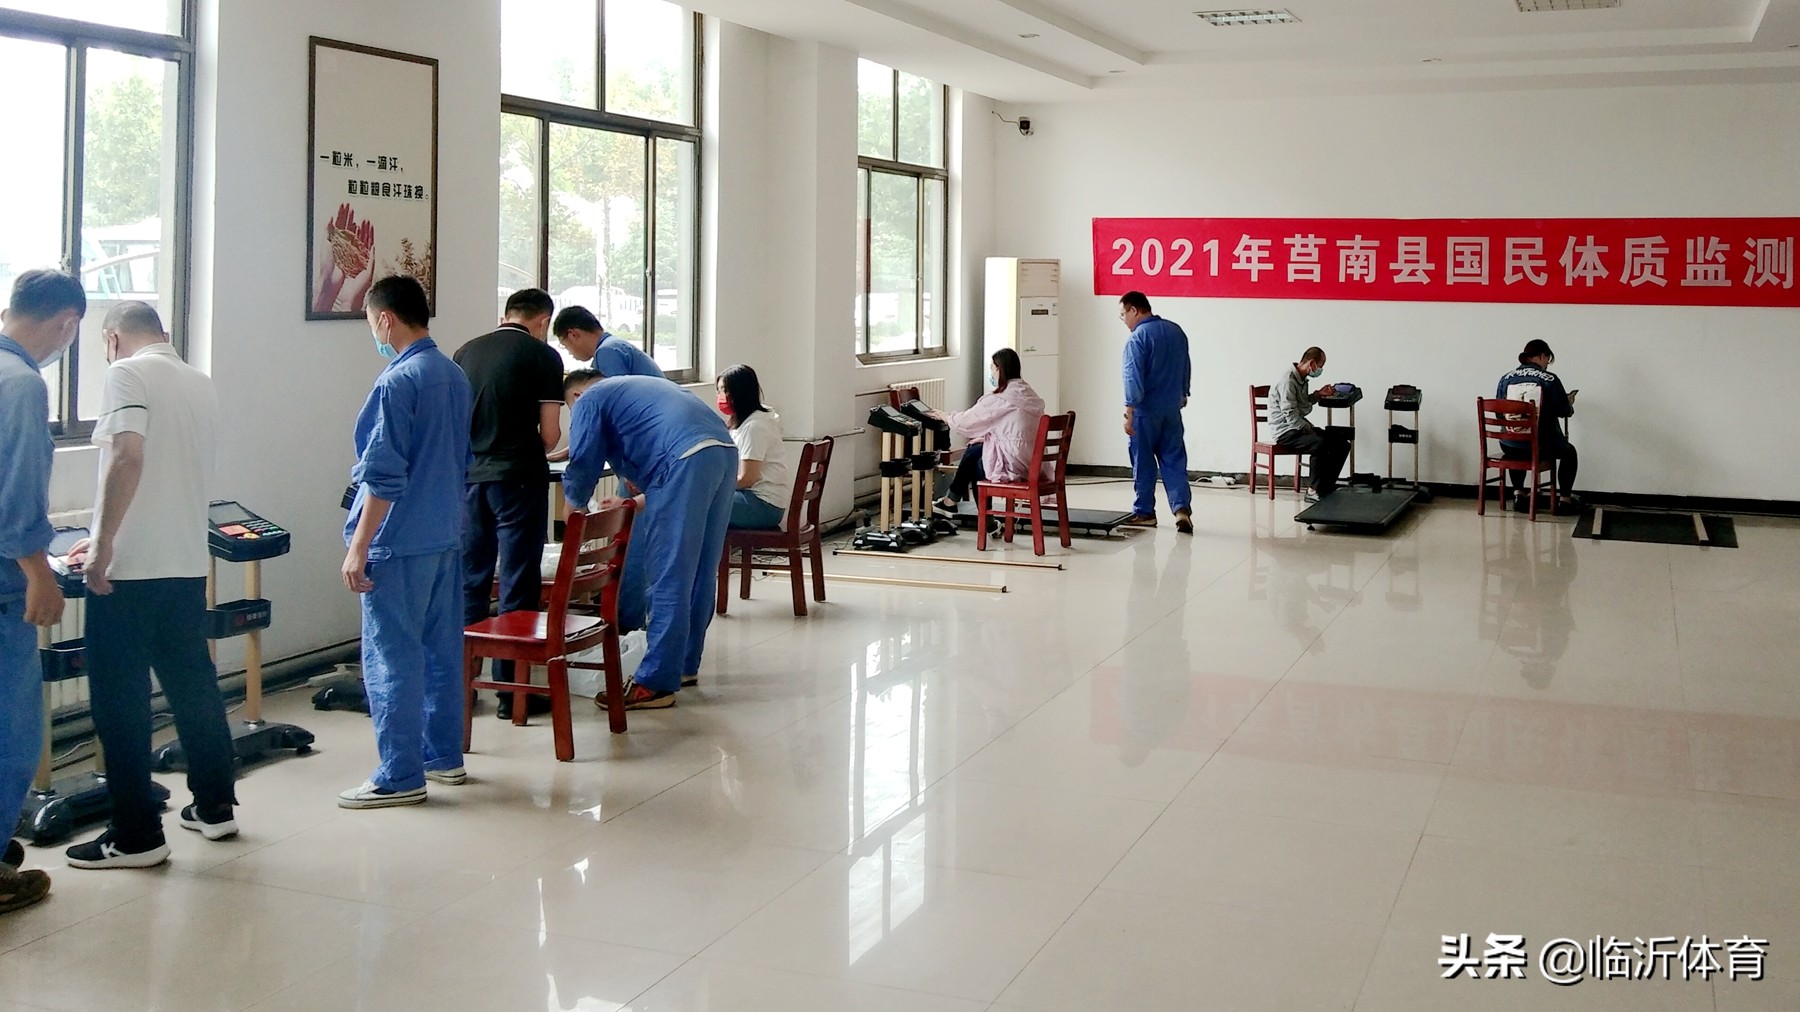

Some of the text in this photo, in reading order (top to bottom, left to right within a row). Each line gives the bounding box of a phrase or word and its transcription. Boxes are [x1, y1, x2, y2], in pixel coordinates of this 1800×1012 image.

[1111, 233, 1794, 289] 2021年莒南县国民体质监测
